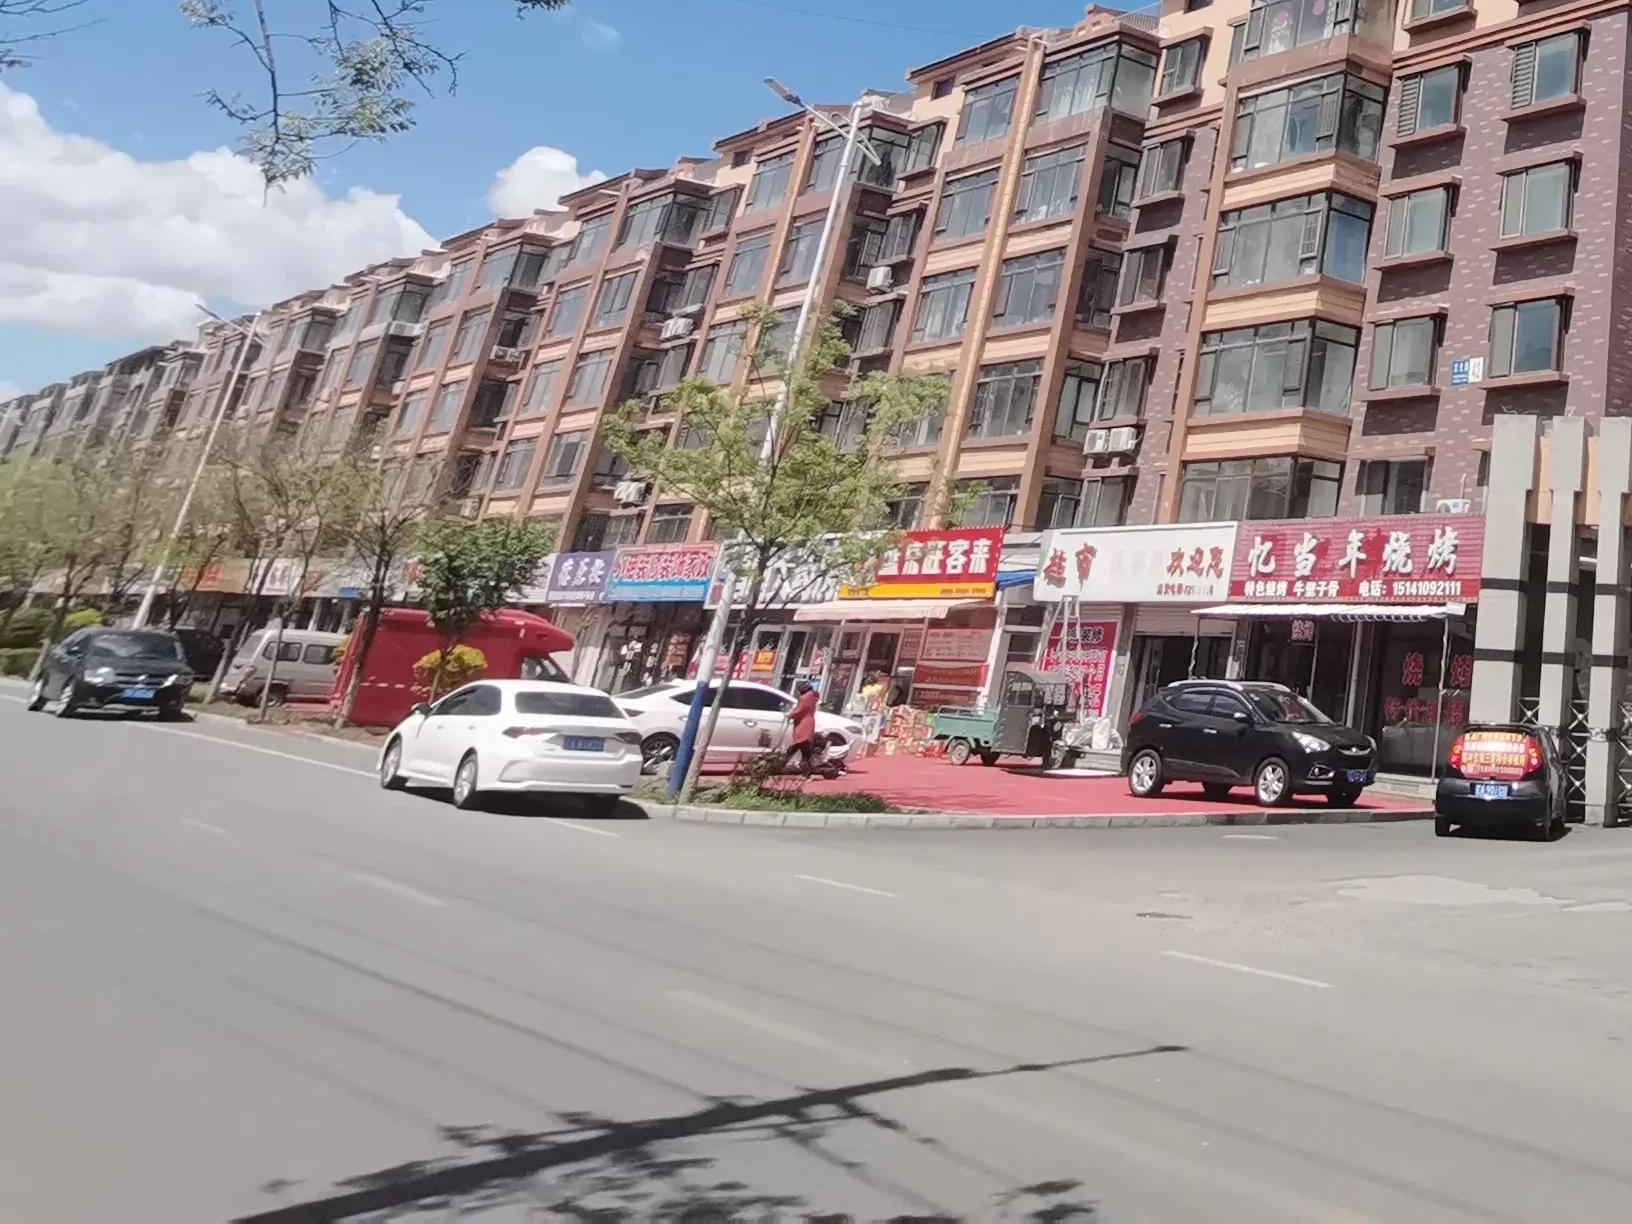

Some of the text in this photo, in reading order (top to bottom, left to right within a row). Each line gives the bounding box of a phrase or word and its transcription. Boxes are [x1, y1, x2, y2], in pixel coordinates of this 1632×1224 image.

[1247, 527, 1459, 577] 忆当年烧烤
